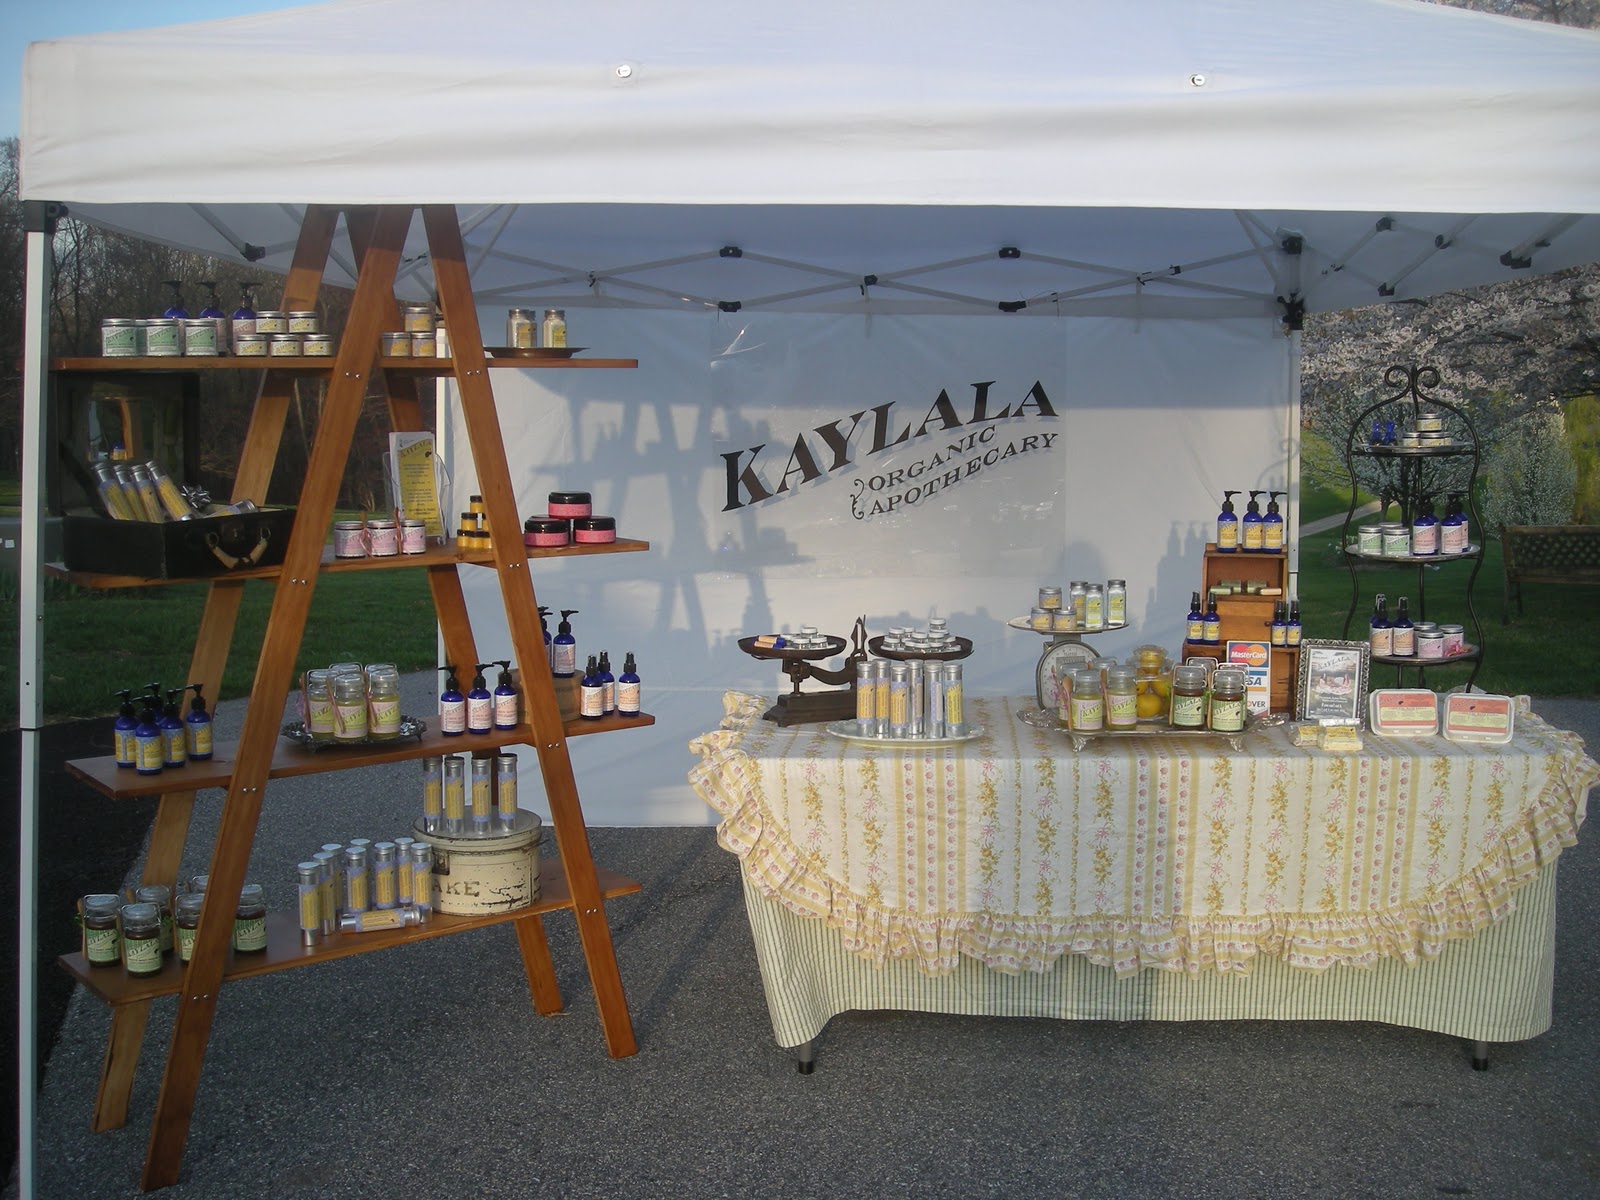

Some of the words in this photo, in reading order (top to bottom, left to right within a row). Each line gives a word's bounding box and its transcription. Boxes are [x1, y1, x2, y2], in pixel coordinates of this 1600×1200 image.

[721, 380, 1059, 512] KAYLALA
[868, 424, 996, 492] ORGANIC
[869, 432, 1059, 516] APOTHECARY
[1230, 651, 1268, 659] MasterCard
[1247, 676, 1262, 686] SA
[431, 878, 480, 897] AKE
